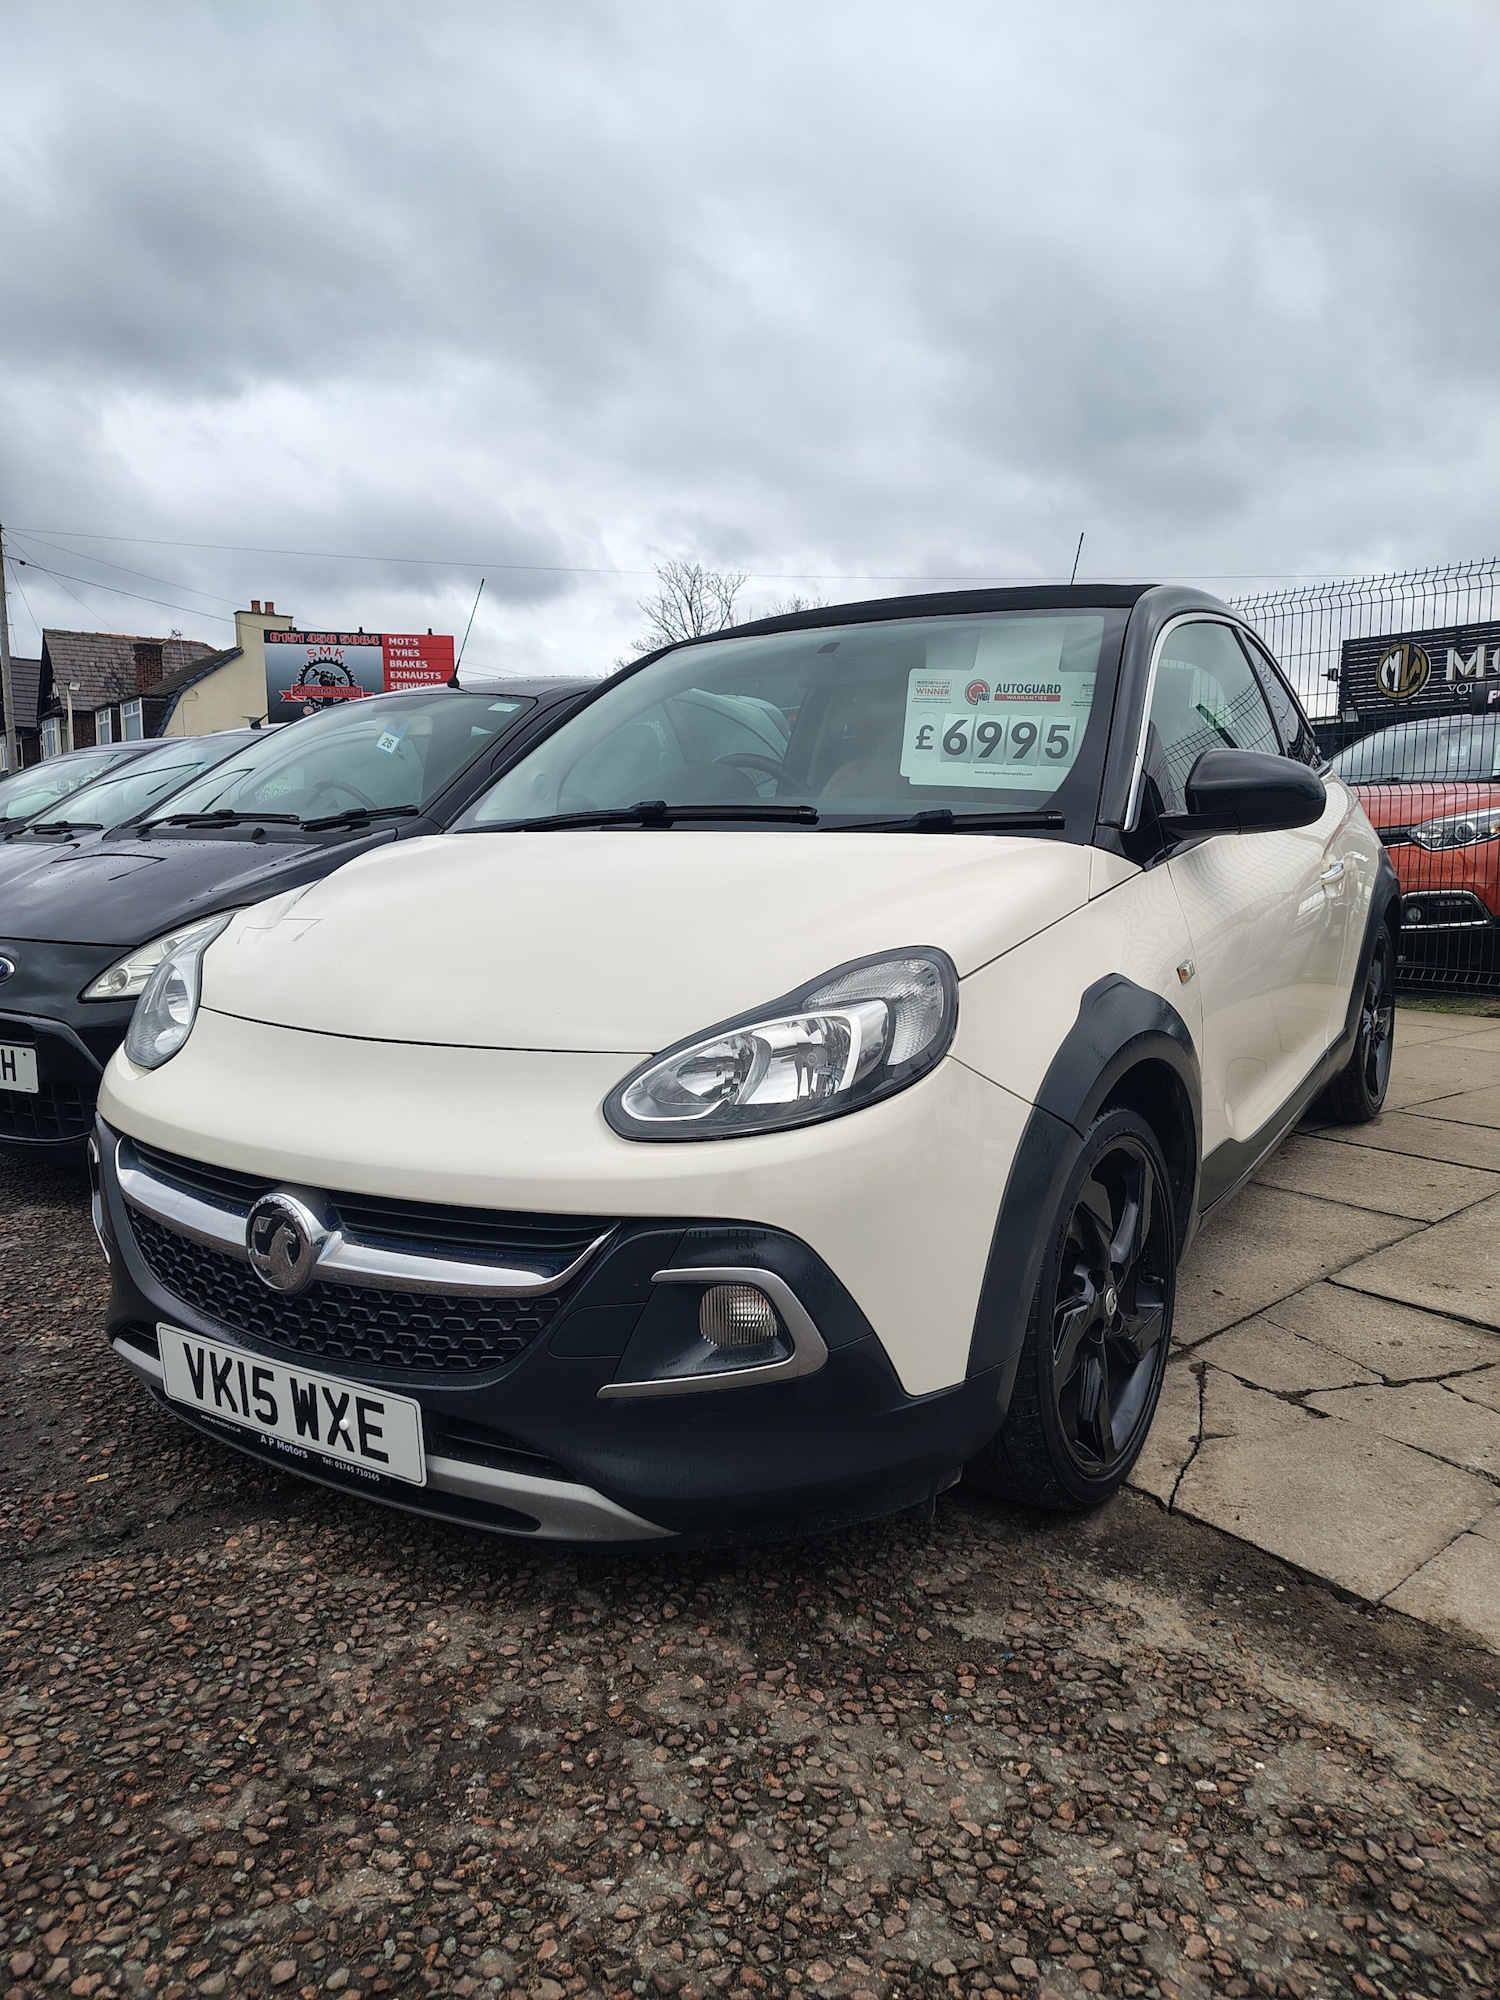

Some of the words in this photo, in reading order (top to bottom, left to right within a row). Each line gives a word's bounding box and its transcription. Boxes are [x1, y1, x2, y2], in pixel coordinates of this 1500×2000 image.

[269, 632, 304, 643] 0151
[307, 632, 337, 644] 458
[339, 633, 380, 646] 5084
[388, 637, 419, 646] MOT'S
[306, 646, 346, 659] SMK
[389, 648, 421, 657] TYRES
[389, 659, 428, 668] BRAKES
[1446, 644, 1500, 681] M
[390, 670, 442, 680] EXHAUSTS
[293, 686, 361, 696] AUTOMOTIVE
[915, 687, 950, 696] WINNER
[995, 683, 1062, 695] AUTOGUARD
[381, 737, 395, 749] 26
[0, 1048, 17, 1082] H
[183, 1341, 279, 1427] VK15
[289, 1376, 390, 1464] WXE
[260, 1434, 268, 1445] A
[268, 1437, 275, 1447] P
[276, 1440, 309, 1459] Motors
